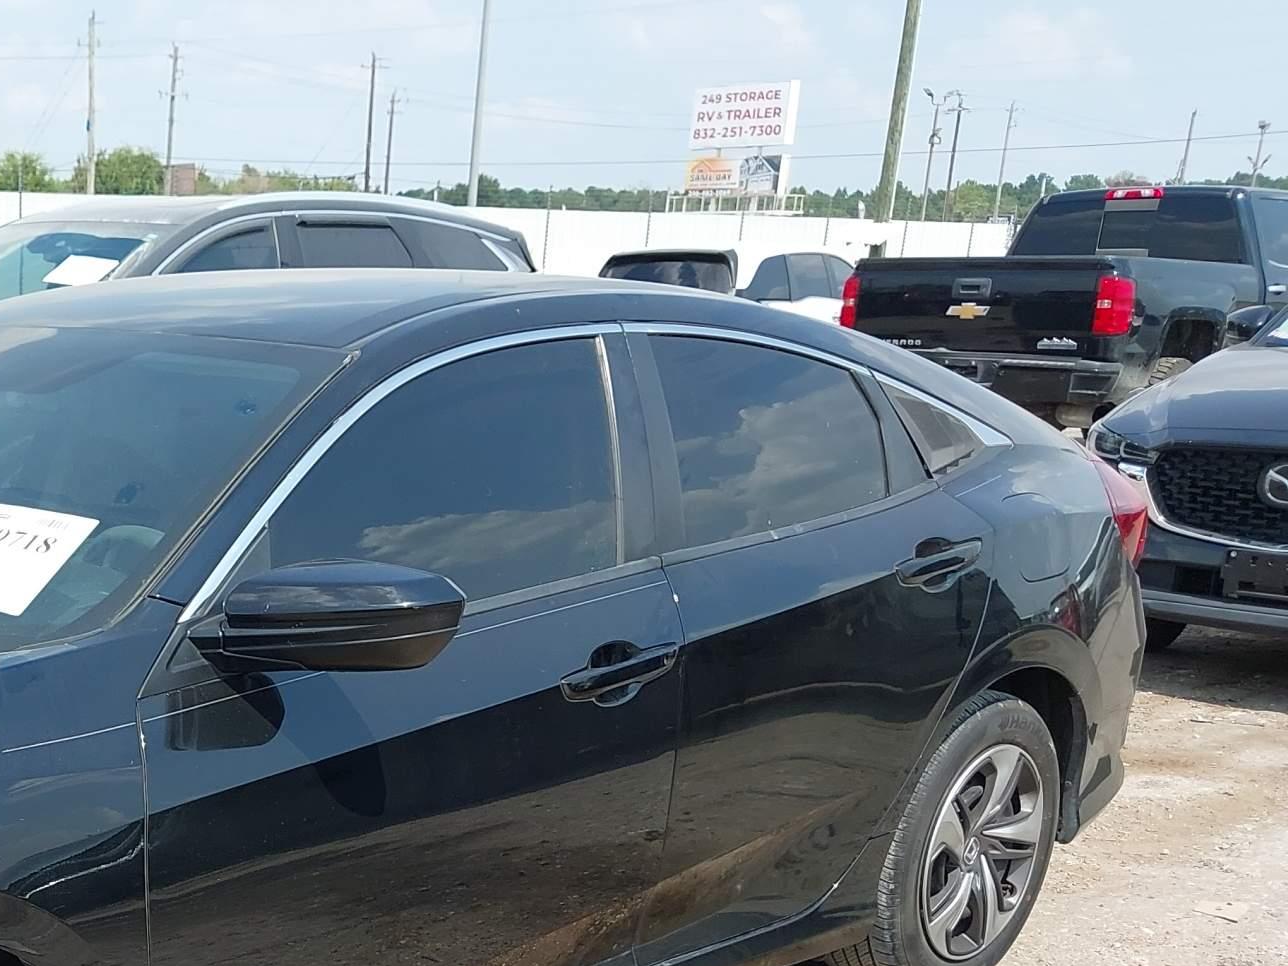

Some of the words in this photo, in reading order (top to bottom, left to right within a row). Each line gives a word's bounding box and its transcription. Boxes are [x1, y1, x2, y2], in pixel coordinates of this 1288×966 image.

[701, 94, 722, 105] 249
[725, 89, 782, 104] STORAGE
[697, 111, 715, 123] RV
[726, 107, 782, 121] TRAILER
[693, 124, 782, 140] 832-251-7300
